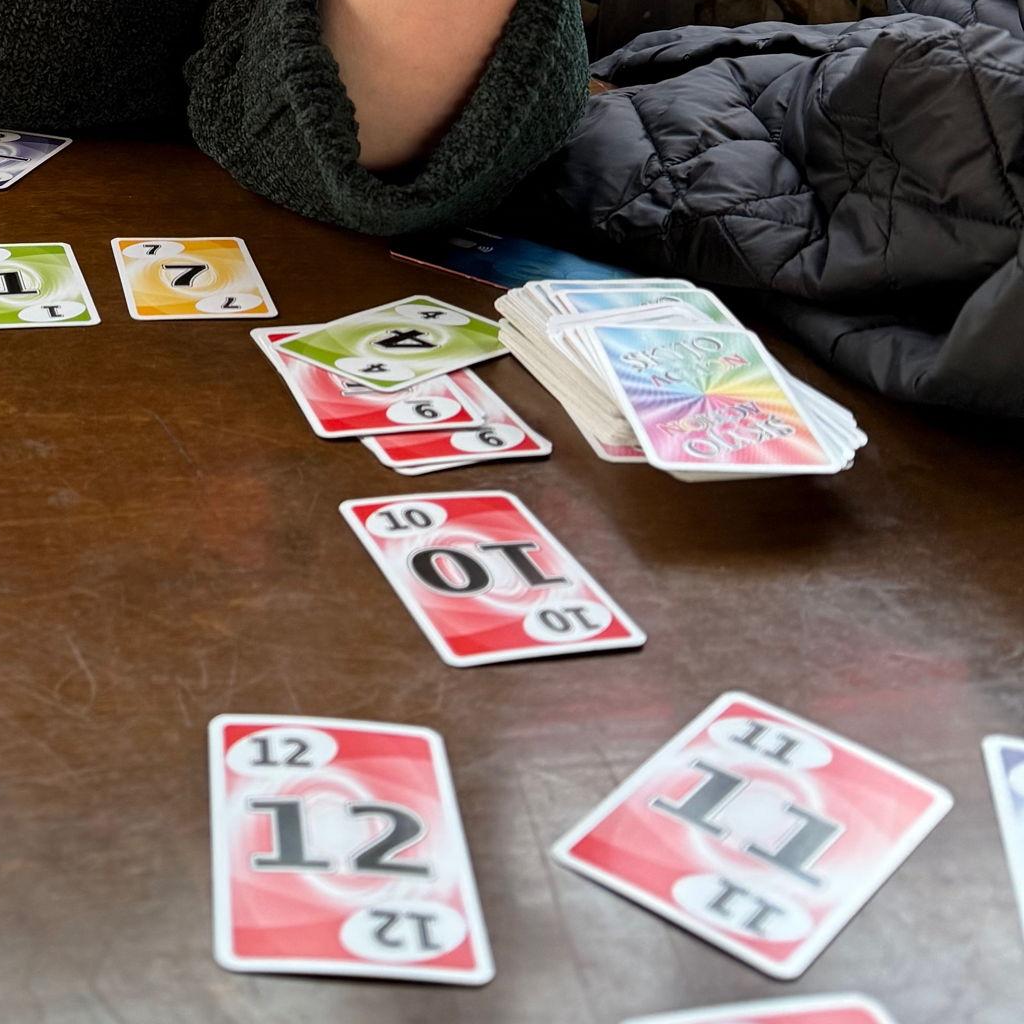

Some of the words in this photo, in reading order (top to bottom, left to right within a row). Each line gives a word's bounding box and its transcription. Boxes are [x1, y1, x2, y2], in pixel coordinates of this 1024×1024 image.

[142, 244, 161, 256] 7
[161, 263, 209, 288] 7
[42, 306, 64, 318] 1
[221, 296, 240, 309] 7
[419, 310, 446, 320] 4
[370, 327, 442, 349] 4
[359, 363, 390, 373] 4
[620, 336, 724, 373] SKYJO
[682, 414, 797, 459] SKYJO
[378, 508, 433, 531] 10
[406, 540, 573, 598] 10
[536, 606, 599, 633] 10
[247, 734, 319, 770] 12
[727, 717, 804, 768] 11
[648, 754, 849, 889] 11
[245, 795, 435, 880] 12
[711, 875, 789, 940] 11
[367, 904, 447, 952] 12
